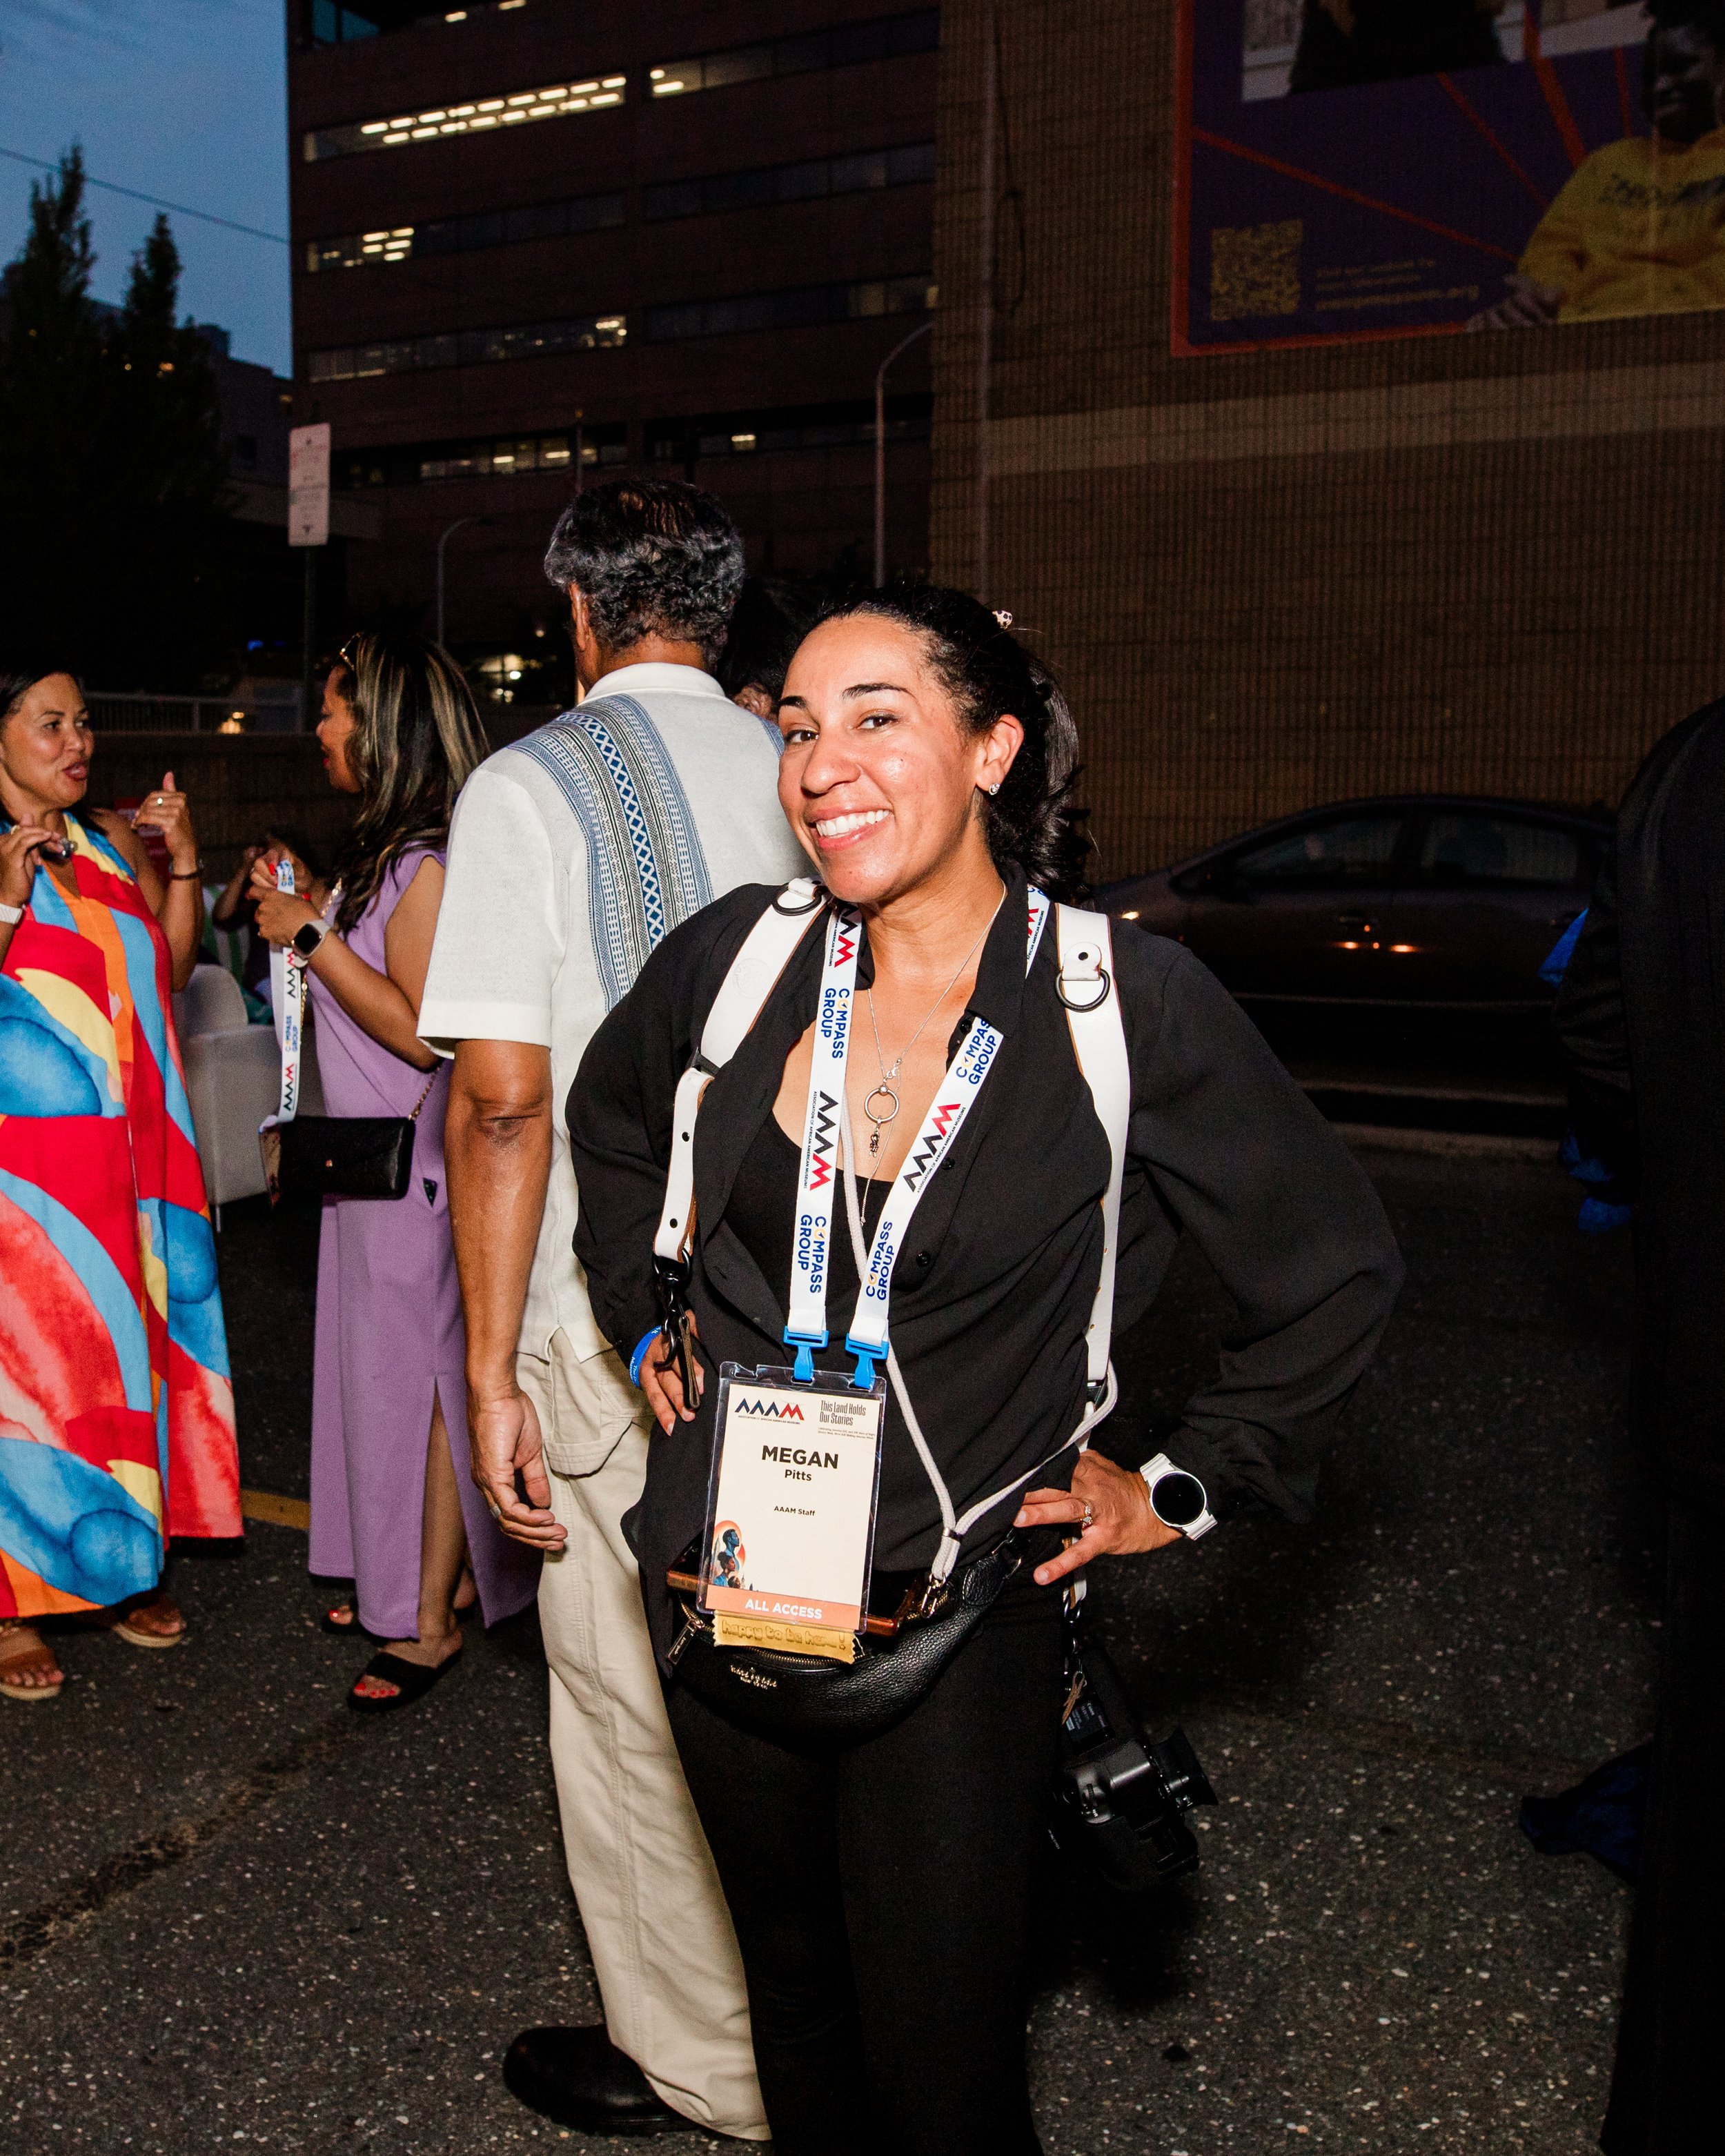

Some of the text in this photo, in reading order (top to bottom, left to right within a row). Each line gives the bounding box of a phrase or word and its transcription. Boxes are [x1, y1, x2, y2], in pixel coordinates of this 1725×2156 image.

[820, 988, 836, 1038] GROUP
[831, 988, 850, 1058] COMPASS
[968, 1035, 996, 1085] GROUP
[917, 1167, 933, 1193] ASSOCIATION
[935, 1146, 946, 1162] AFRICAN
[944, 1126, 956, 1146] AMERICAN
[954, 1107, 966, 1126] MUSEUMS
[798, 1214, 813, 1270] GROUP
[809, 1216, 827, 1294] COMPASS
[866, 1221, 893, 1297] COMPASS
[877, 1245, 894, 1300] GROUP
[819, 1411, 854, 1426] Our Stories
[820, 1400, 866, 1416] This Land Holds
[762, 1445, 838, 1469] MEGAN
[785, 1469, 812, 1481] Pitts
[773, 1505, 796, 1514] AAAM
[722, 1620, 763, 1641] happy
[765, 1625, 783, 1641] to
[785, 1628, 802, 1643] be
[745, 1598, 823, 1619] ALL ACCESS
